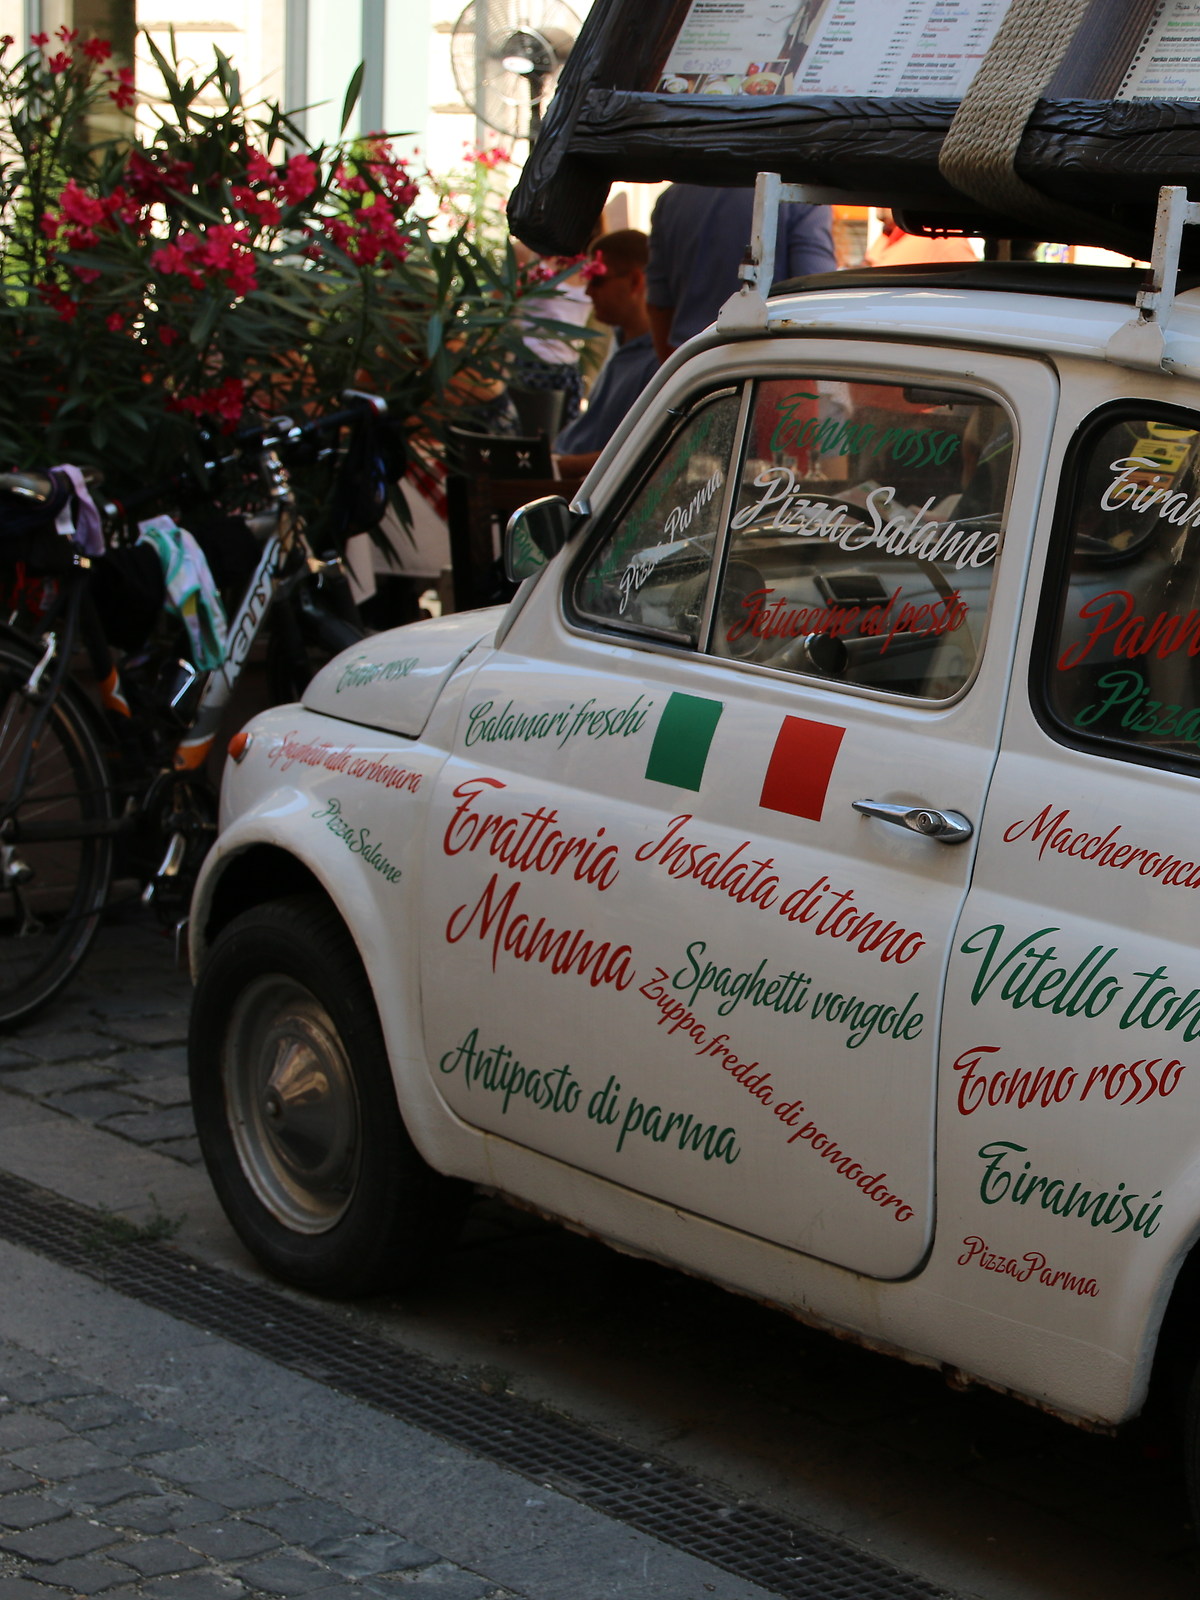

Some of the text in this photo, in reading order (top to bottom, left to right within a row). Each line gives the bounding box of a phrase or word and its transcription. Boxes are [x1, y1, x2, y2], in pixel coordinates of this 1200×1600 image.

[769, 392, 962, 469] Tonno rosso
[664, 469, 722, 544] Parma
[731, 467, 849, 542] Pizza
[840, 486, 1000, 570] Salame
[860, 586, 903, 637] al
[880, 590, 969, 655] pesto
[378, 657, 420, 682] rosso
[465, 694, 653, 750] Calamari freschi
[323, 744, 356, 773] alla
[347, 753, 423, 794] carbonara
[312, 798, 403, 885] Pizza Salame
[441, 776, 621, 892] Trattoria
[445, 873, 637, 992] Mamma
[635, 814, 926, 965] Insalata di tonno
[672, 941, 925, 1050] Spaghetti vongole
[961, 923, 1123, 1020] Vitello
[440, 1028, 741, 1165] Antipasto di parma
[638, 967, 915, 1223] Zuppa fredda di pomodoro
[953, 1045, 1187, 1116] Tonno rosso
[977, 1141, 1167, 1239] Tiramisú
[957, 1235, 1101, 1298] Pizza Parma
